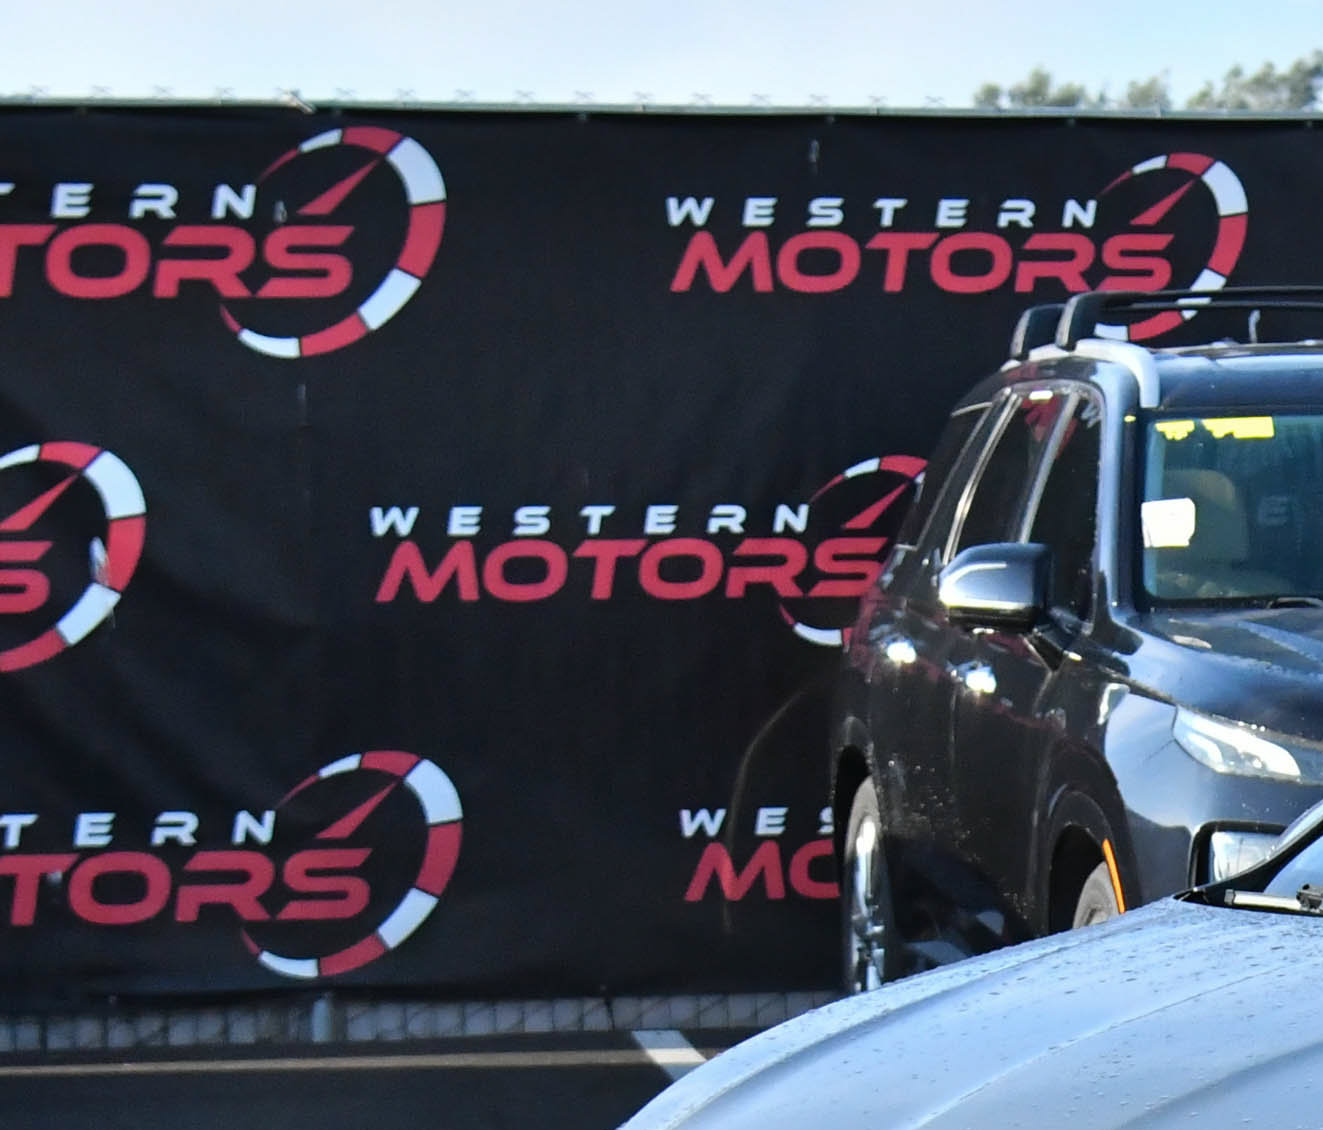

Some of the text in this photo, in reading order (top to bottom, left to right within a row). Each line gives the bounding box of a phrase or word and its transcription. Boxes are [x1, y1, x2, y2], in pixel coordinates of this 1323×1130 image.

[666, 197, 1097, 228] WESTERN
[669, 230, 1175, 294] MOTORS
[369, 504, 810, 537] WESTERN
[375, 537, 888, 603] MOTORS
